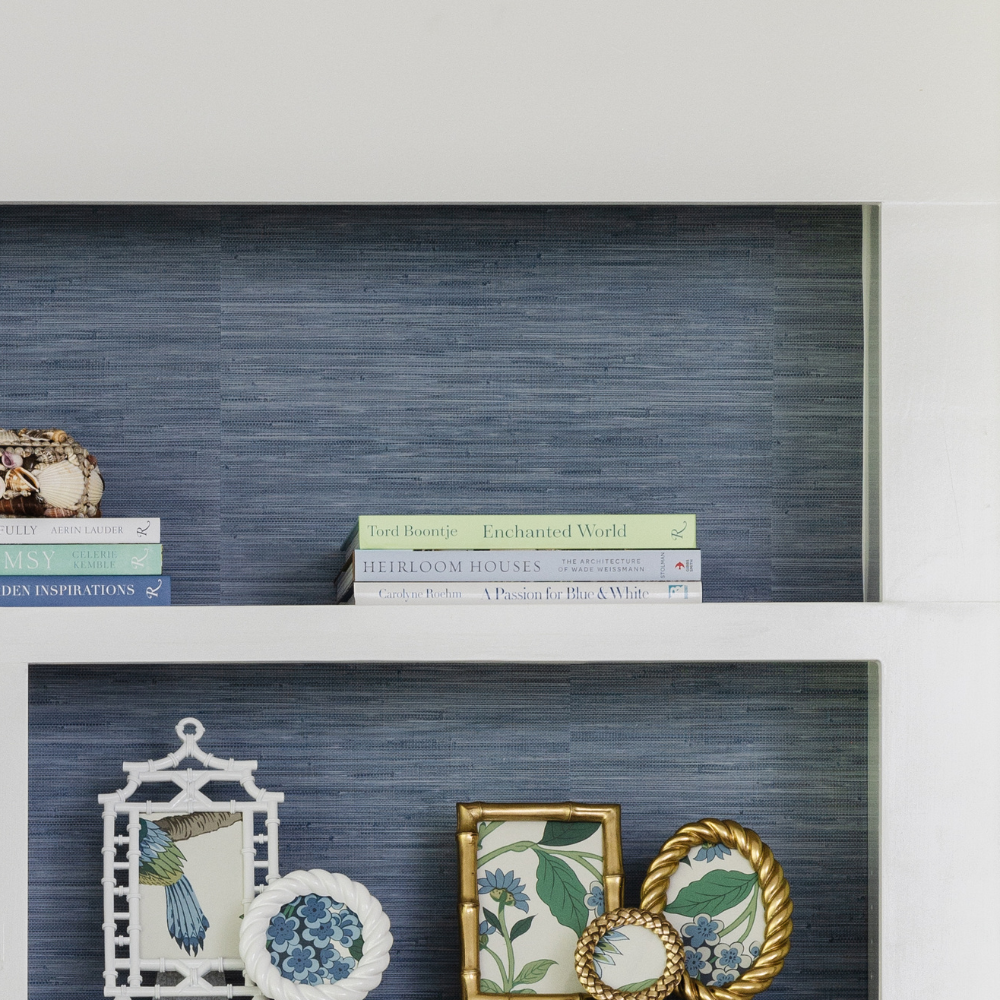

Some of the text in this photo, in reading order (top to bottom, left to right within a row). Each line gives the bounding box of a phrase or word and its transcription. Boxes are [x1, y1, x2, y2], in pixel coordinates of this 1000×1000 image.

[51, 526, 82, 534] AERIN
[85, 526, 124, 534] LAUDER
[367, 524, 458, 540] Tord Boontje
[483, 523, 627, 539] Enchanted World
[72, 550, 118, 559] CELERIE
[73, 561, 116, 569] KEMBLE
[363, 560, 541, 573] HEIRLOOM HOUSES
[35, 584, 135, 596] INSPIRATIONS
[378, 588, 462, 602] Carolyne Roehm
[481, 586, 649, 600] A Passion for Blue & White
